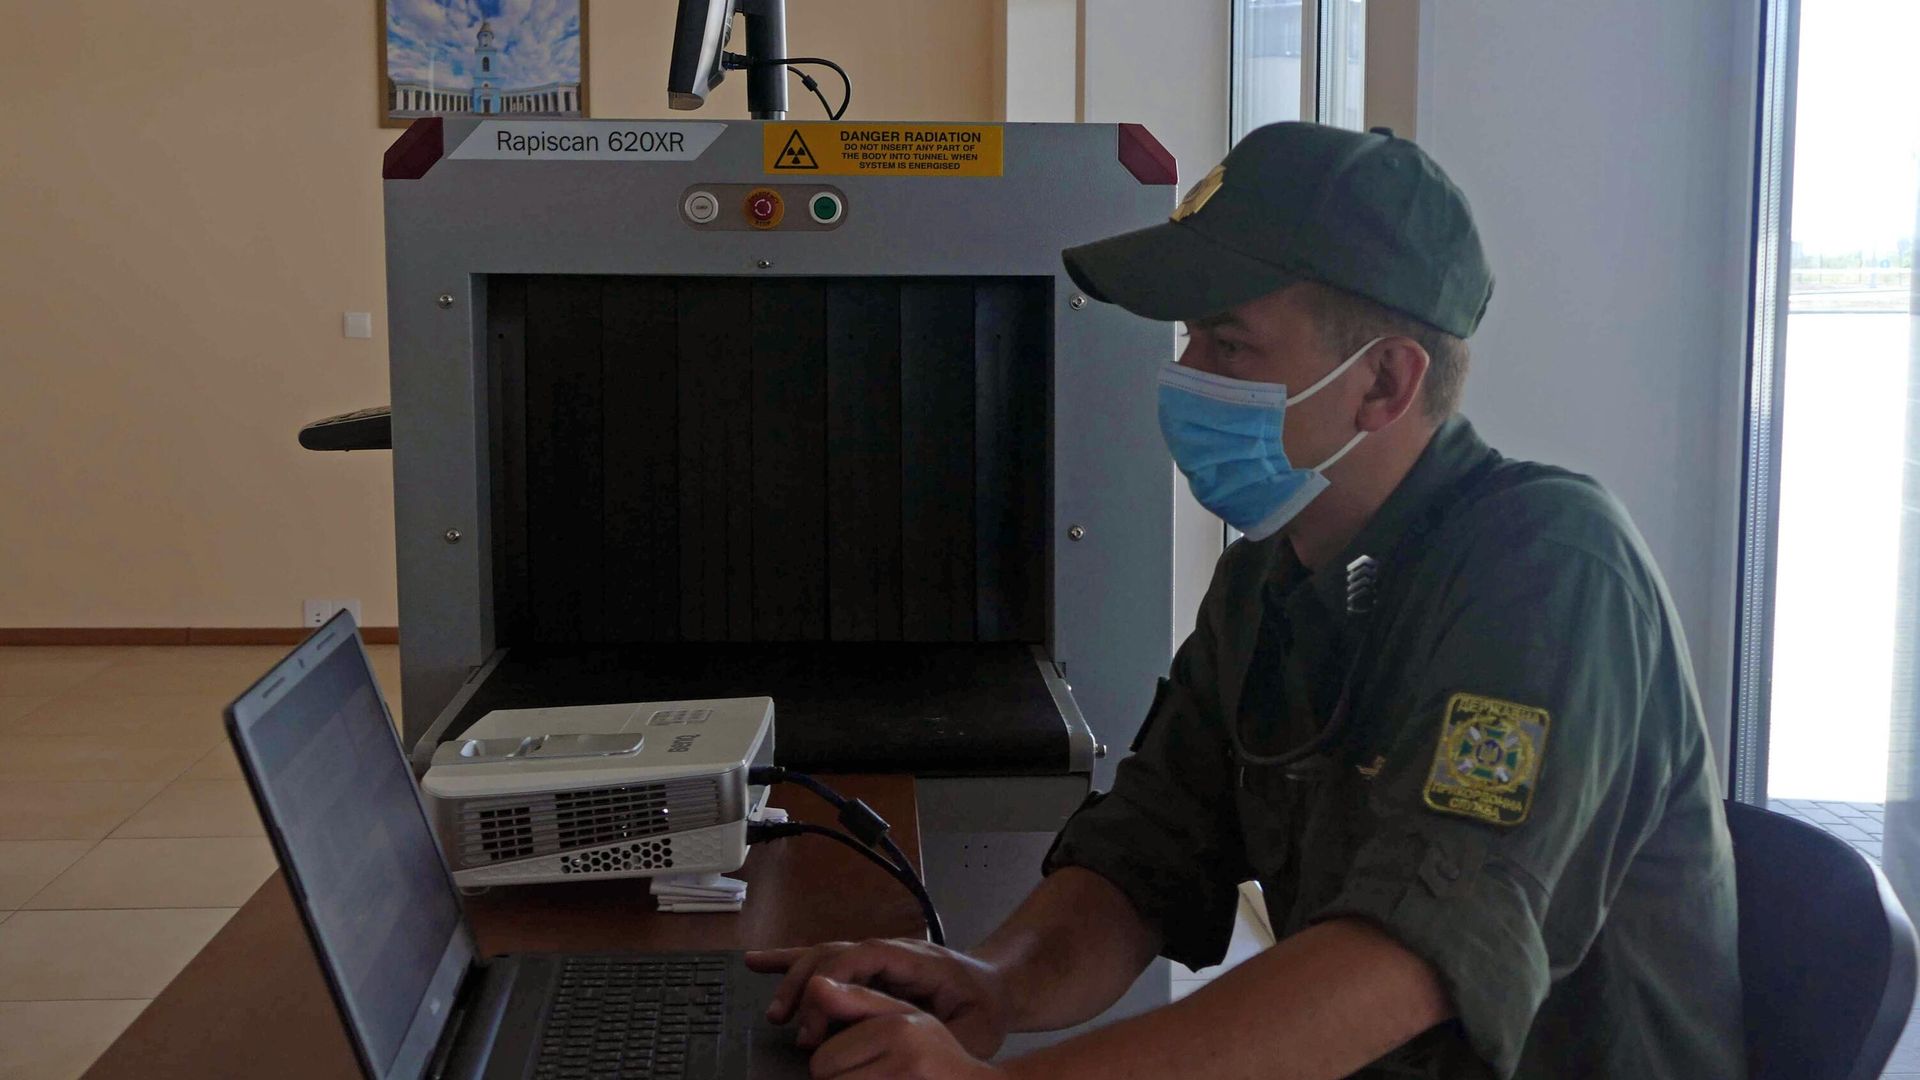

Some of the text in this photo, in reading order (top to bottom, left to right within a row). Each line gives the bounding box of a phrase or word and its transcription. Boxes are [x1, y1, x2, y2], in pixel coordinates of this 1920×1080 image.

[840, 130, 981, 143] DANGER RADIATION
[497, 131, 685, 156] Rapiscan 620XR
[844, 143, 976, 152] DO NOT INSERT ANY PART OF
[841, 152, 978, 161] THE BODY INTO TUNNEL WHEN
[859, 161, 961, 170] SYSTEM IS ENERGISED
